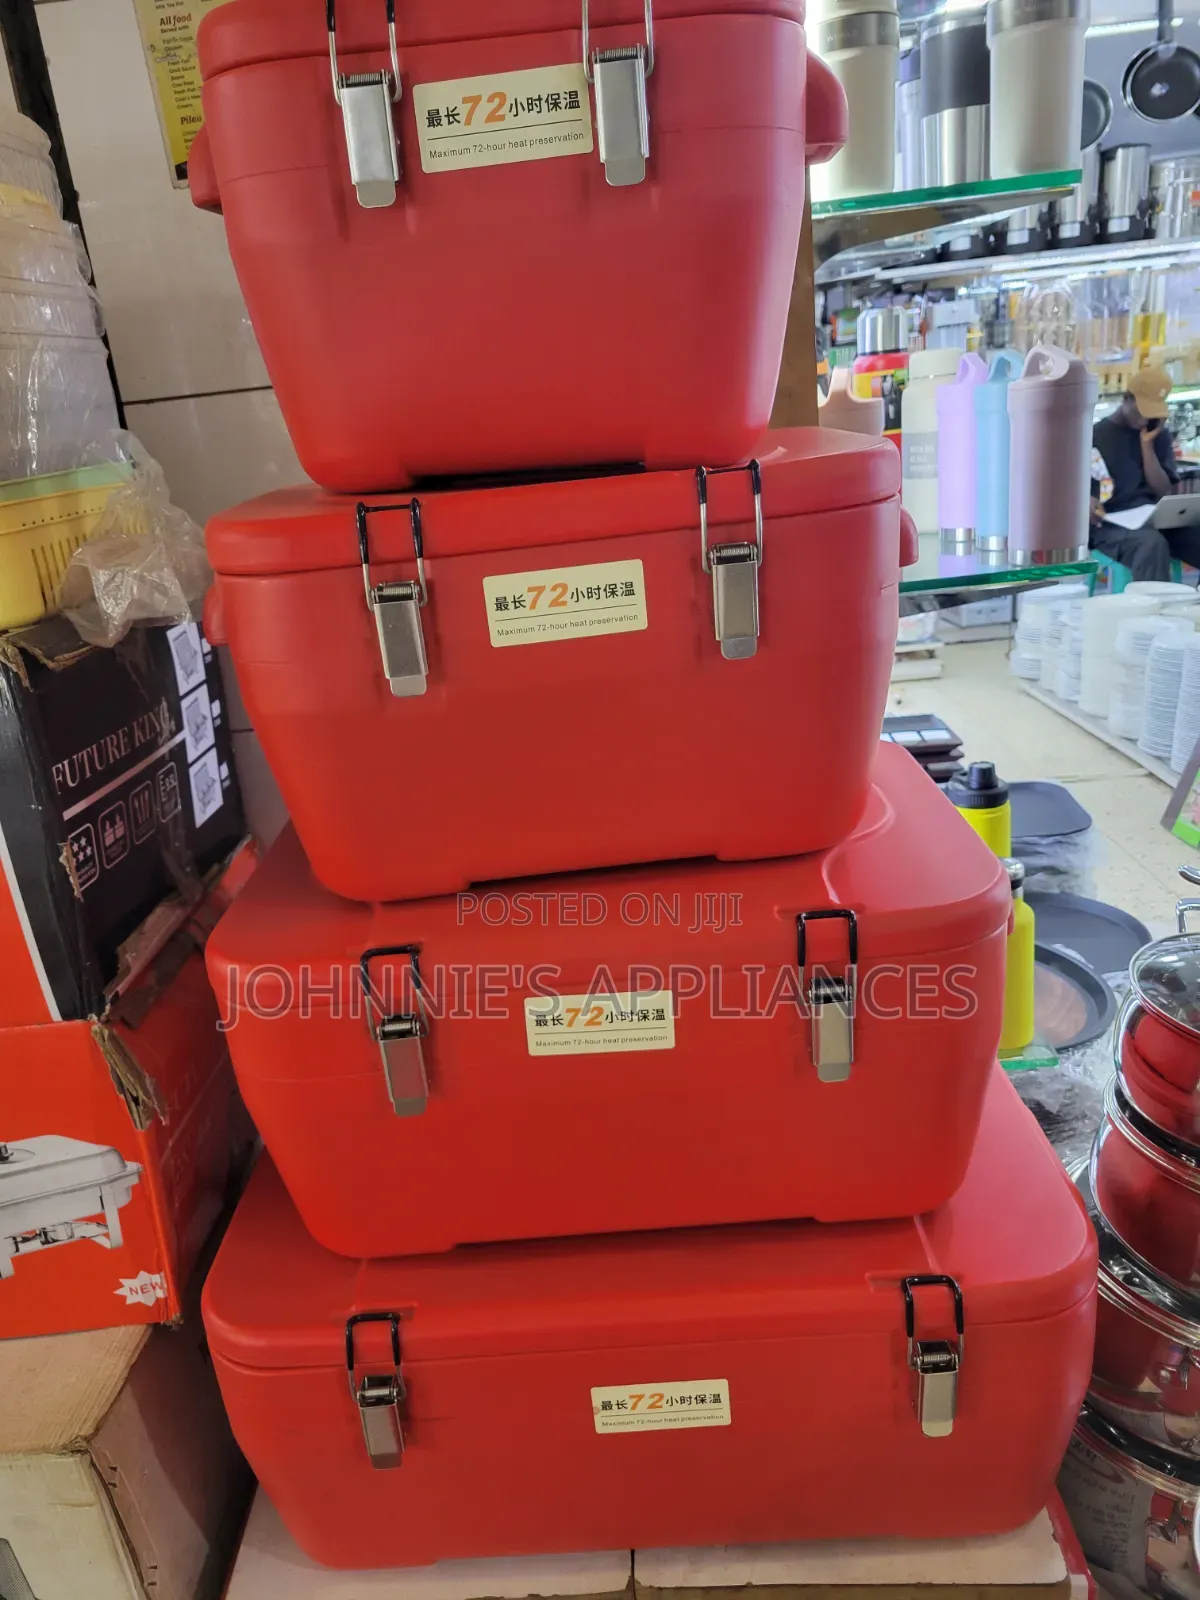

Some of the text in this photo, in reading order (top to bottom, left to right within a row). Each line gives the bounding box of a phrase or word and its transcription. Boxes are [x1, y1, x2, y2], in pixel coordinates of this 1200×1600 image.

[160, 12, 192, 26] All food
[160, 26, 177, 34] Served
[426, 90, 580, 128] 最长72小时保温
[181, 115, 201, 125] Pilau
[429, 132, 584, 159] Maximum 72-hour heat preservation
[494, 581, 635, 611] 最长72小时保温
[497, 614, 638, 636] Maximum 72-hour heat preservation
[52, 727, 131, 795] FUTURE
[535, 1006, 666, 1028] 最长72小时保温
[621, 1034, 668, 1045] preservation
[129, 1281, 163, 1296] NEW
[601, 1393, 722, 1411] 最长72小时保温
